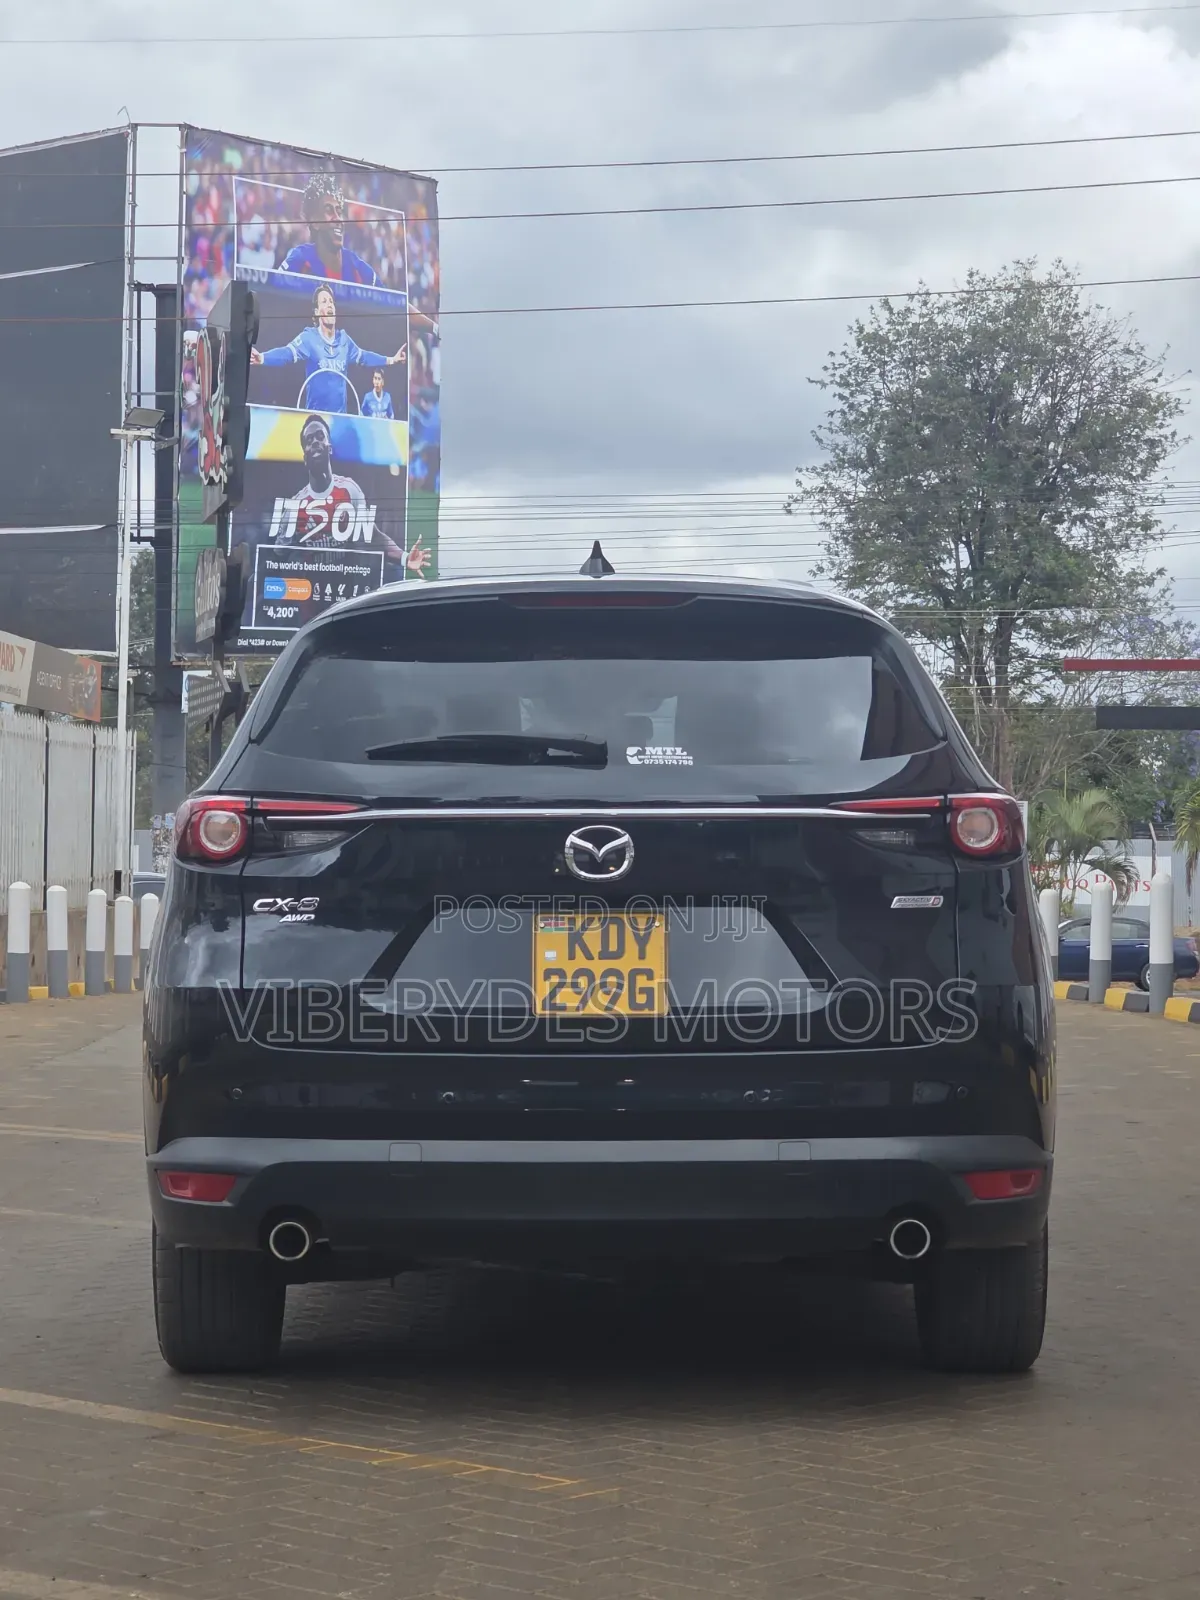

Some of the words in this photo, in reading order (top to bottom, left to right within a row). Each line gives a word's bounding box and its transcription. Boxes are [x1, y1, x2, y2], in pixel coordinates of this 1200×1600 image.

[268, 495, 334, 543] IT'S
[332, 502, 377, 543] ON
[266, 560, 278, 570] The
[280, 561, 303, 571] world's
[304, 562, 318, 572] best
[319, 562, 344, 573] football
[344, 563, 371, 576] package
[267, 606, 294, 619] 4,200
[237, 638, 249, 646] Dial
[0, 642, 16, 673] ARD
[644, 746, 687, 755] MTL
[252, 897, 320, 912] CX-8
[279, 913, 316, 924] AWD
[568, 916, 656, 961] KDY
[541, 967, 655, 1012] 299G
